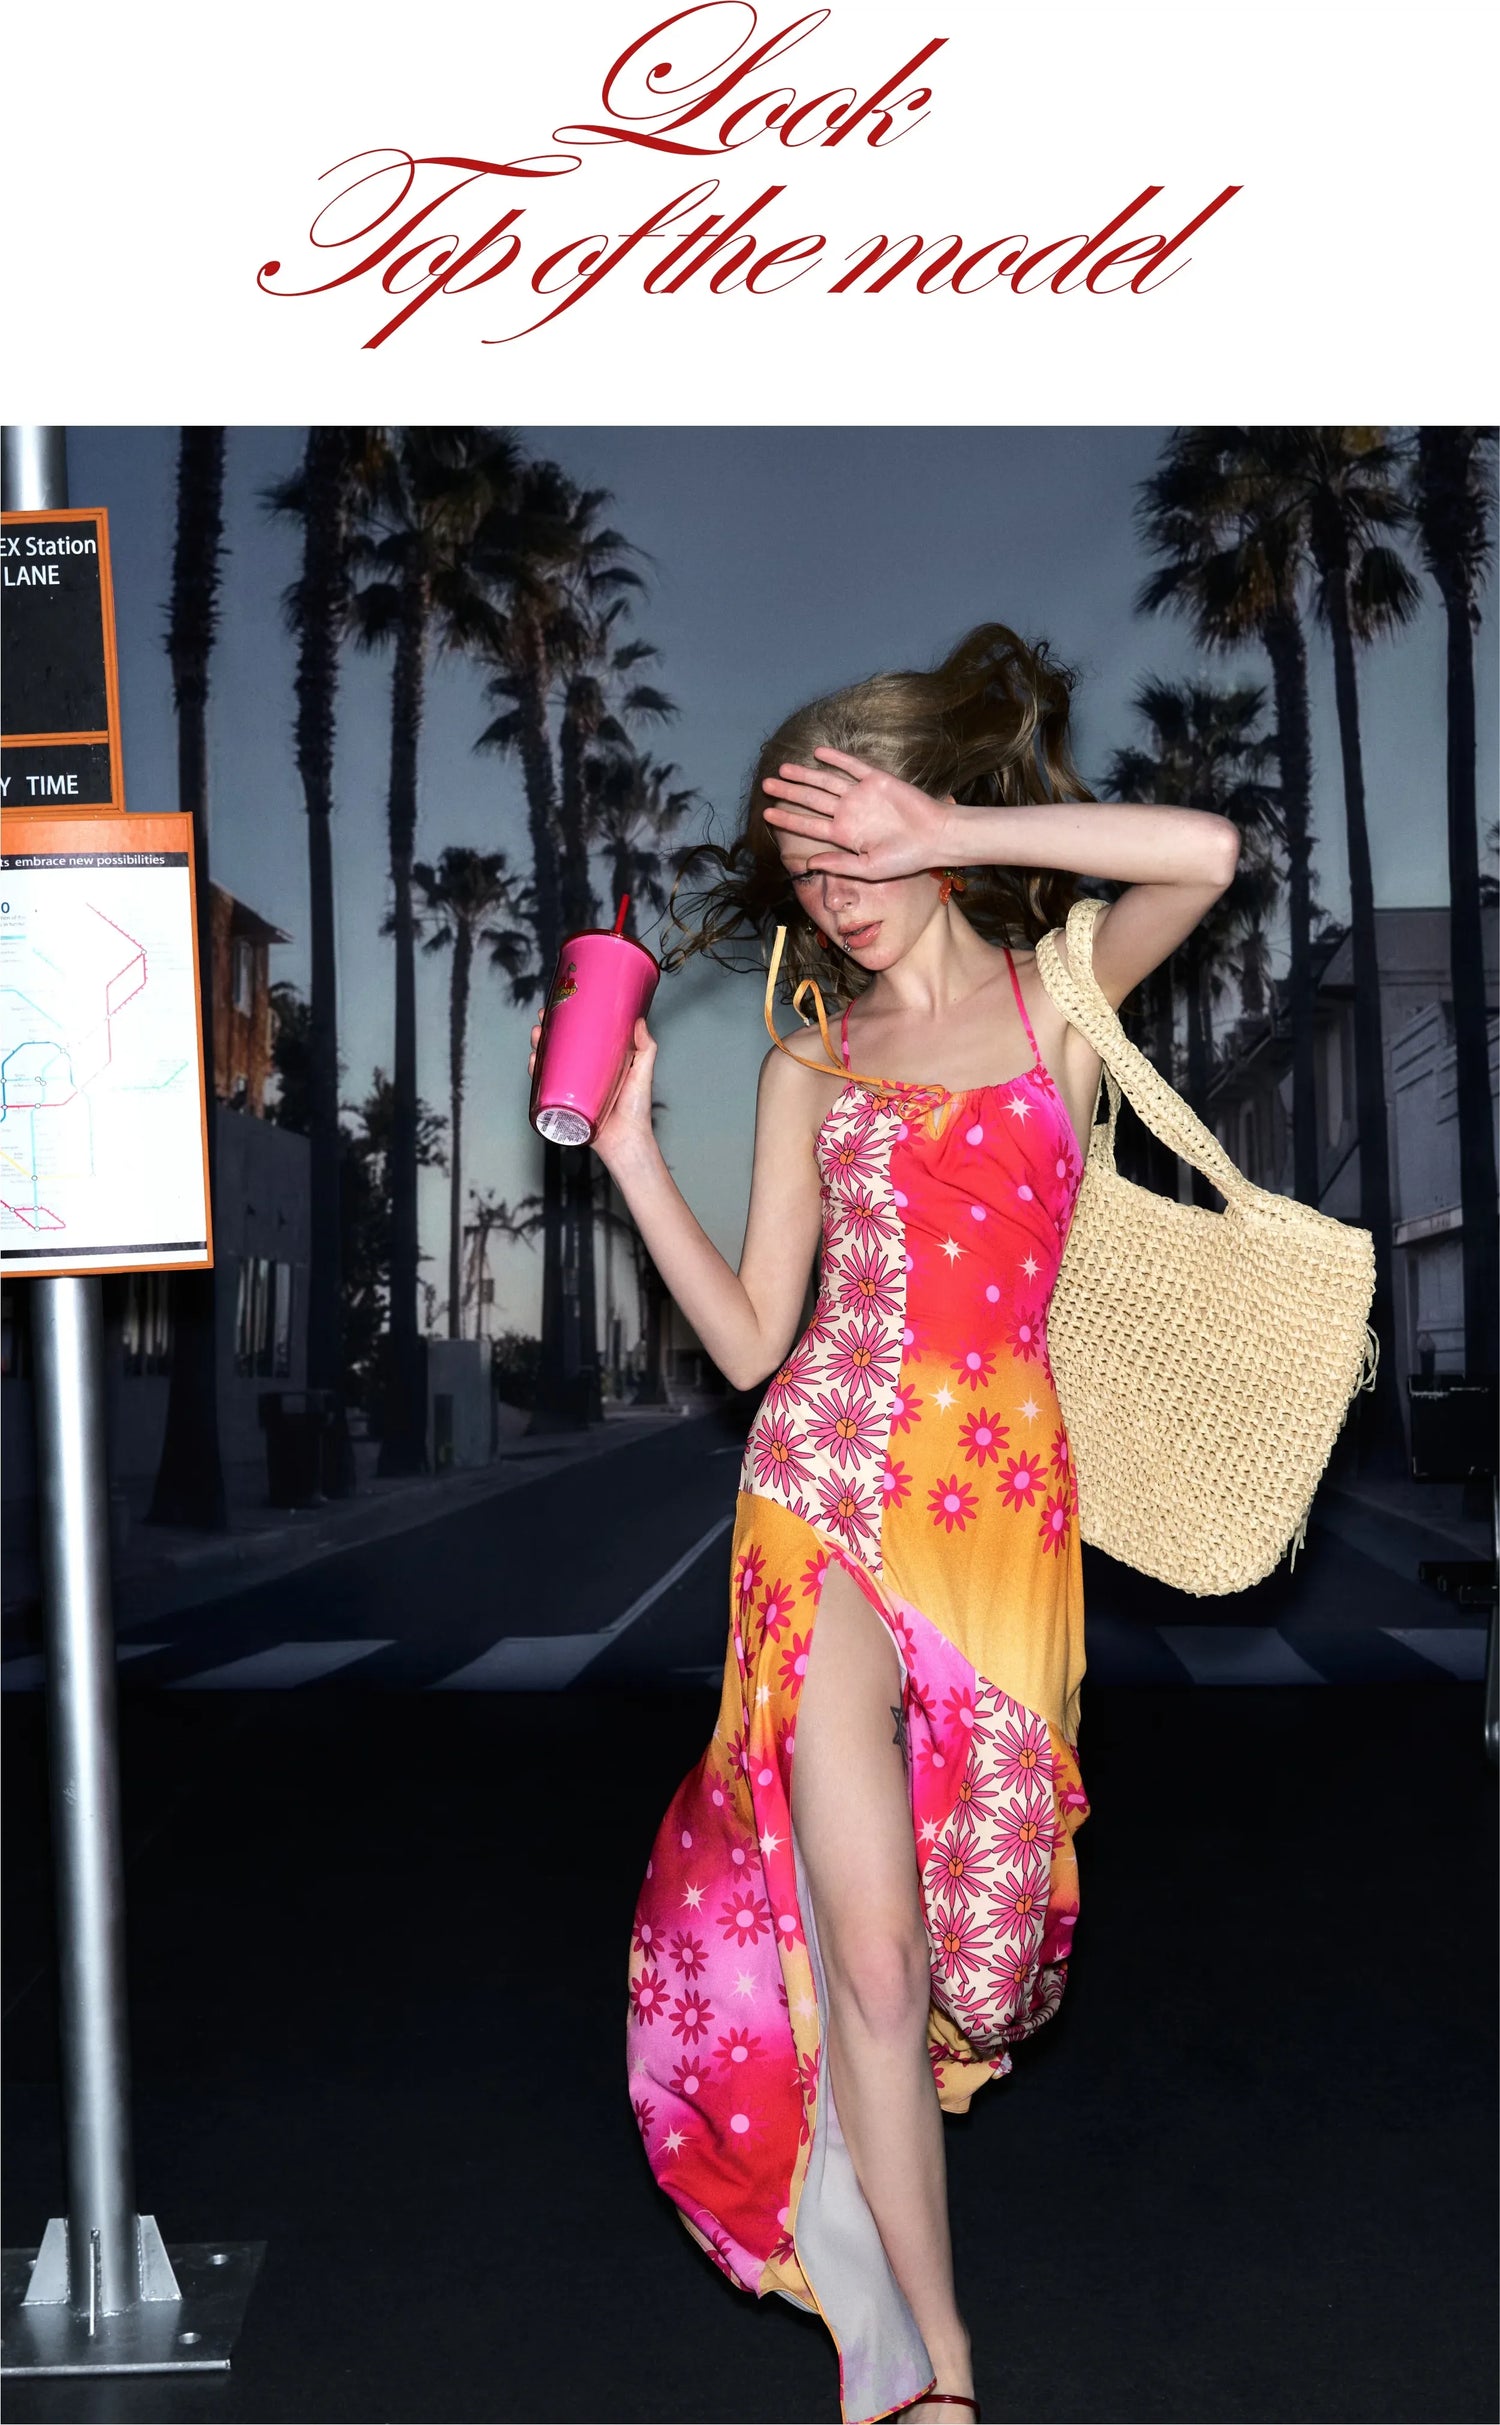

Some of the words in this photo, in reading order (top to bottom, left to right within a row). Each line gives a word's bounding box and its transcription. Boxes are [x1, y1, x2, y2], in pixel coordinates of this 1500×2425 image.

[25, 535, 97, 557] Station
[4, 565, 60, 587] LANE
[25, 774, 79, 796] TIME
[14, 856, 67, 867] embrace
[69, 857, 94, 866] new
[96, 854, 165, 868] possibilities
